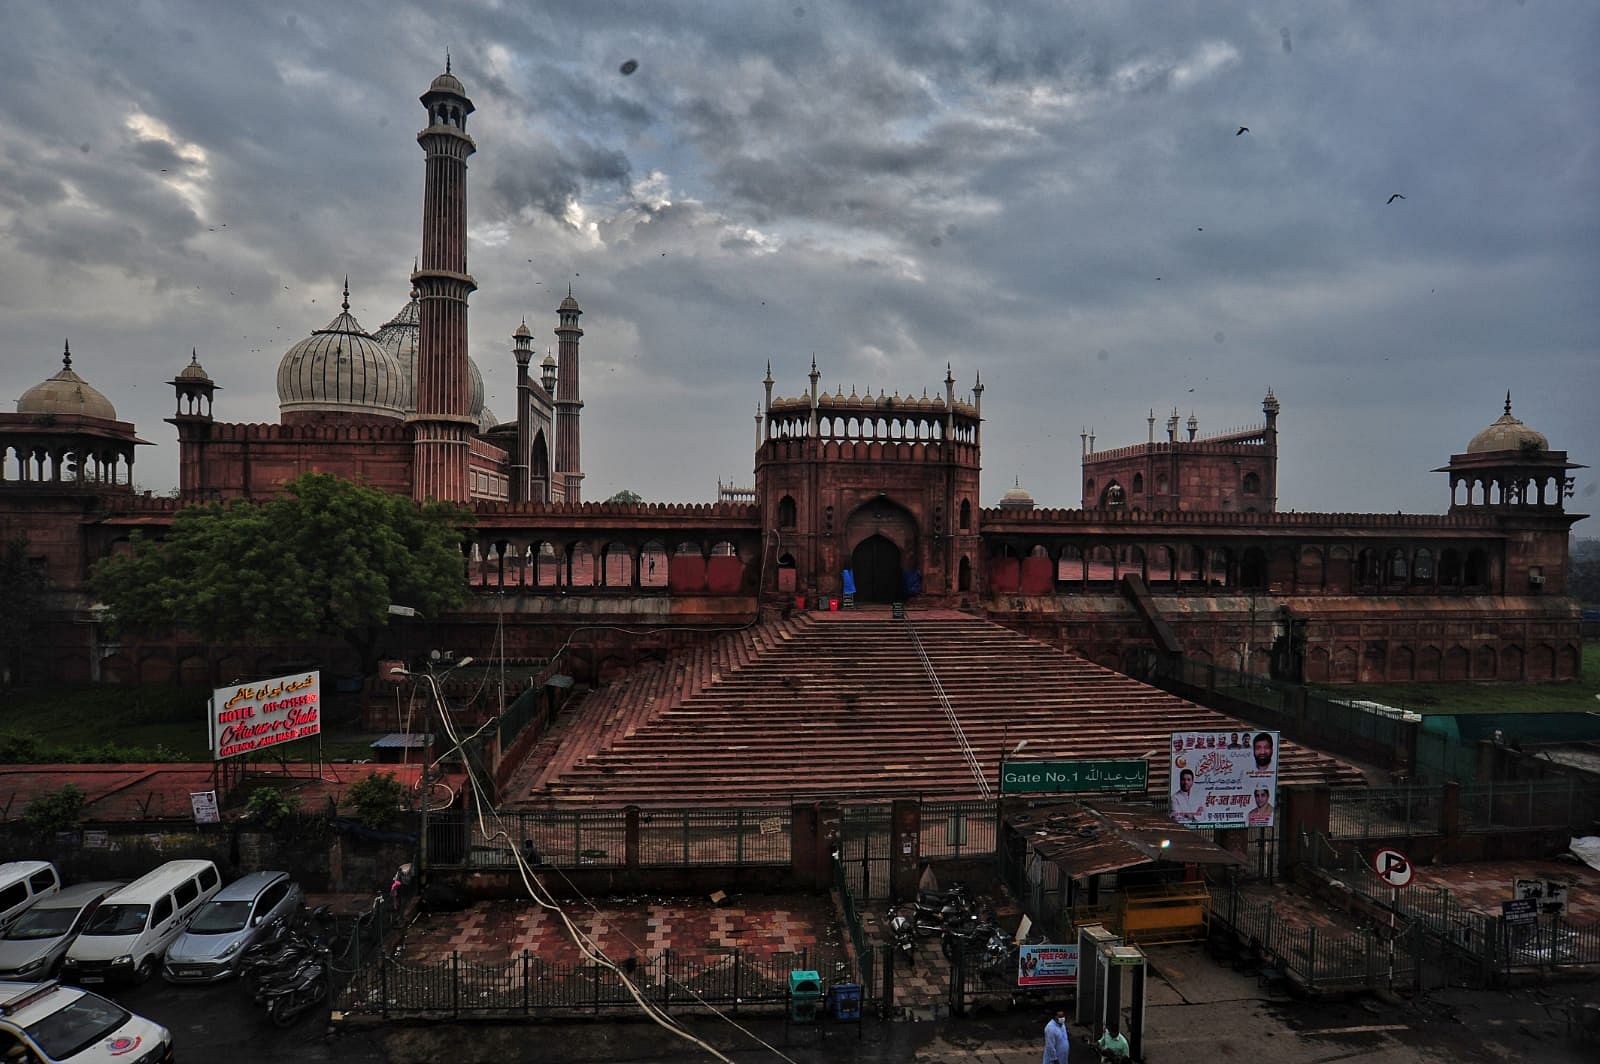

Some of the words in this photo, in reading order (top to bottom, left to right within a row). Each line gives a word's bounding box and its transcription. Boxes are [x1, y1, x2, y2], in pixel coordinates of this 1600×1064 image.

[218, 706, 256, 724] HOTEL
[1005, 773, 1041, 783] Gate
[1046, 771, 1078, 782] No.1
[1039, 952, 1054, 960] FREE
[1055, 952, 1069, 960] FOR
